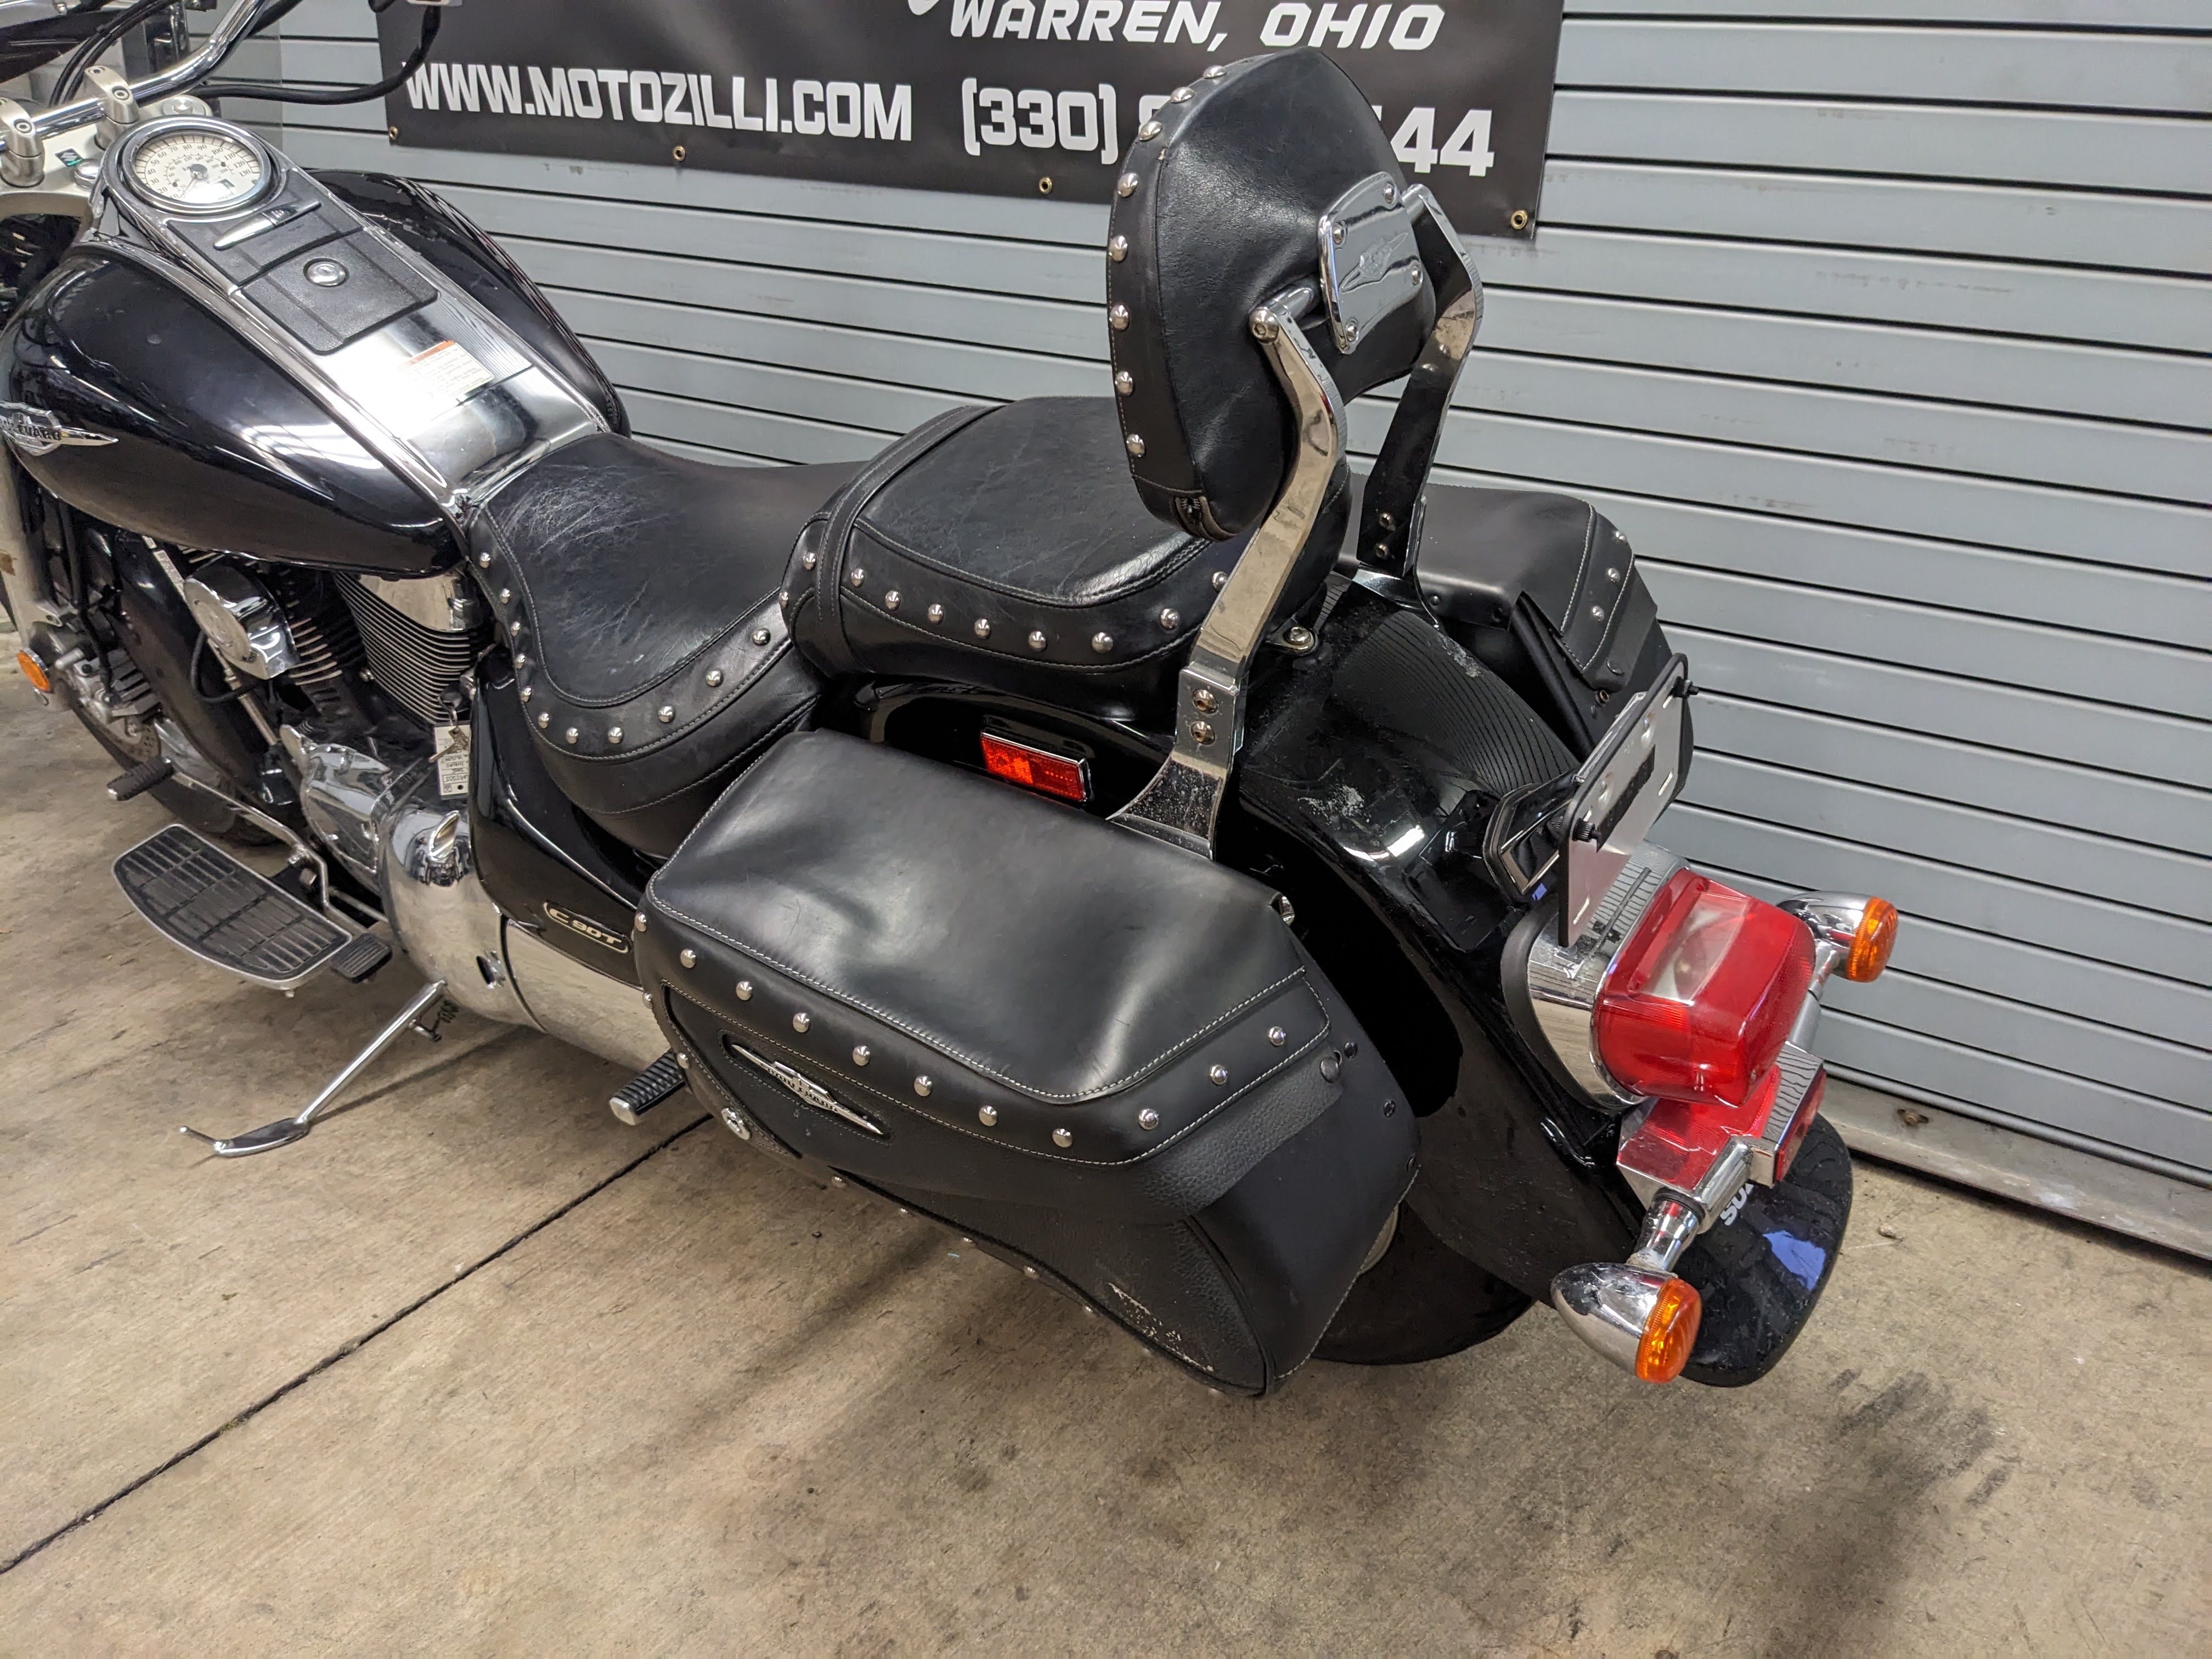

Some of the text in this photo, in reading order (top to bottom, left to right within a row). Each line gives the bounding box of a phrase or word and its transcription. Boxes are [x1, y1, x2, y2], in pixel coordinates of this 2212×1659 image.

[951, 0, 1445, 51] WARREN, OHIO
[401, 61, 912, 142] WWW.MOTOZILLI.COM
[962, 77, 1119, 165] (330)
